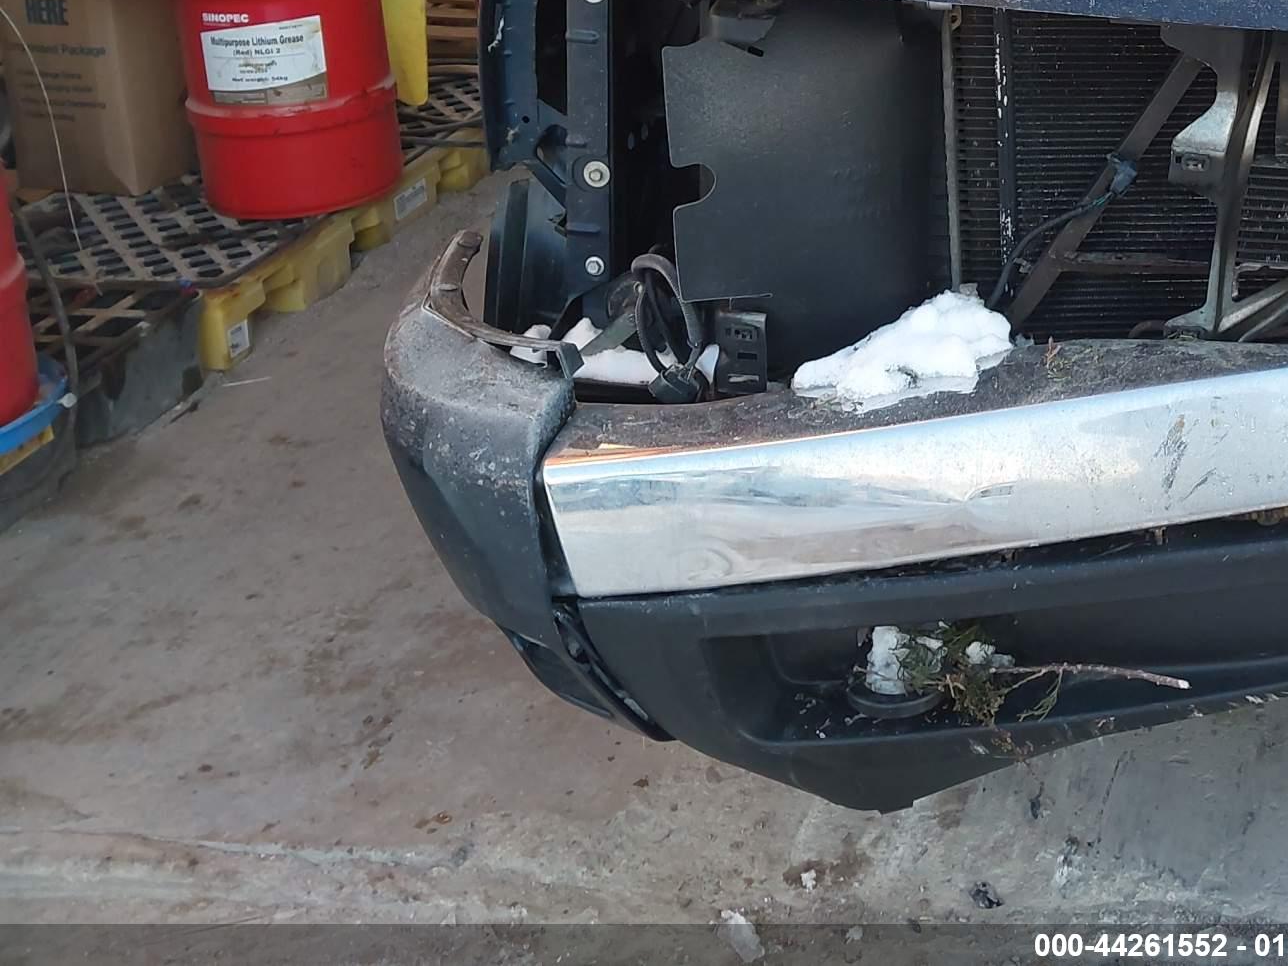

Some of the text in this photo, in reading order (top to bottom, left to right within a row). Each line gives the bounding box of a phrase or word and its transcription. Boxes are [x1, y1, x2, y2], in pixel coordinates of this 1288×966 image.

[202, 13, 250, 23] SINOPEC
[210, 34, 304, 47] Multipurpose Lithium Grease
[61, 44, 106, 57] Package
